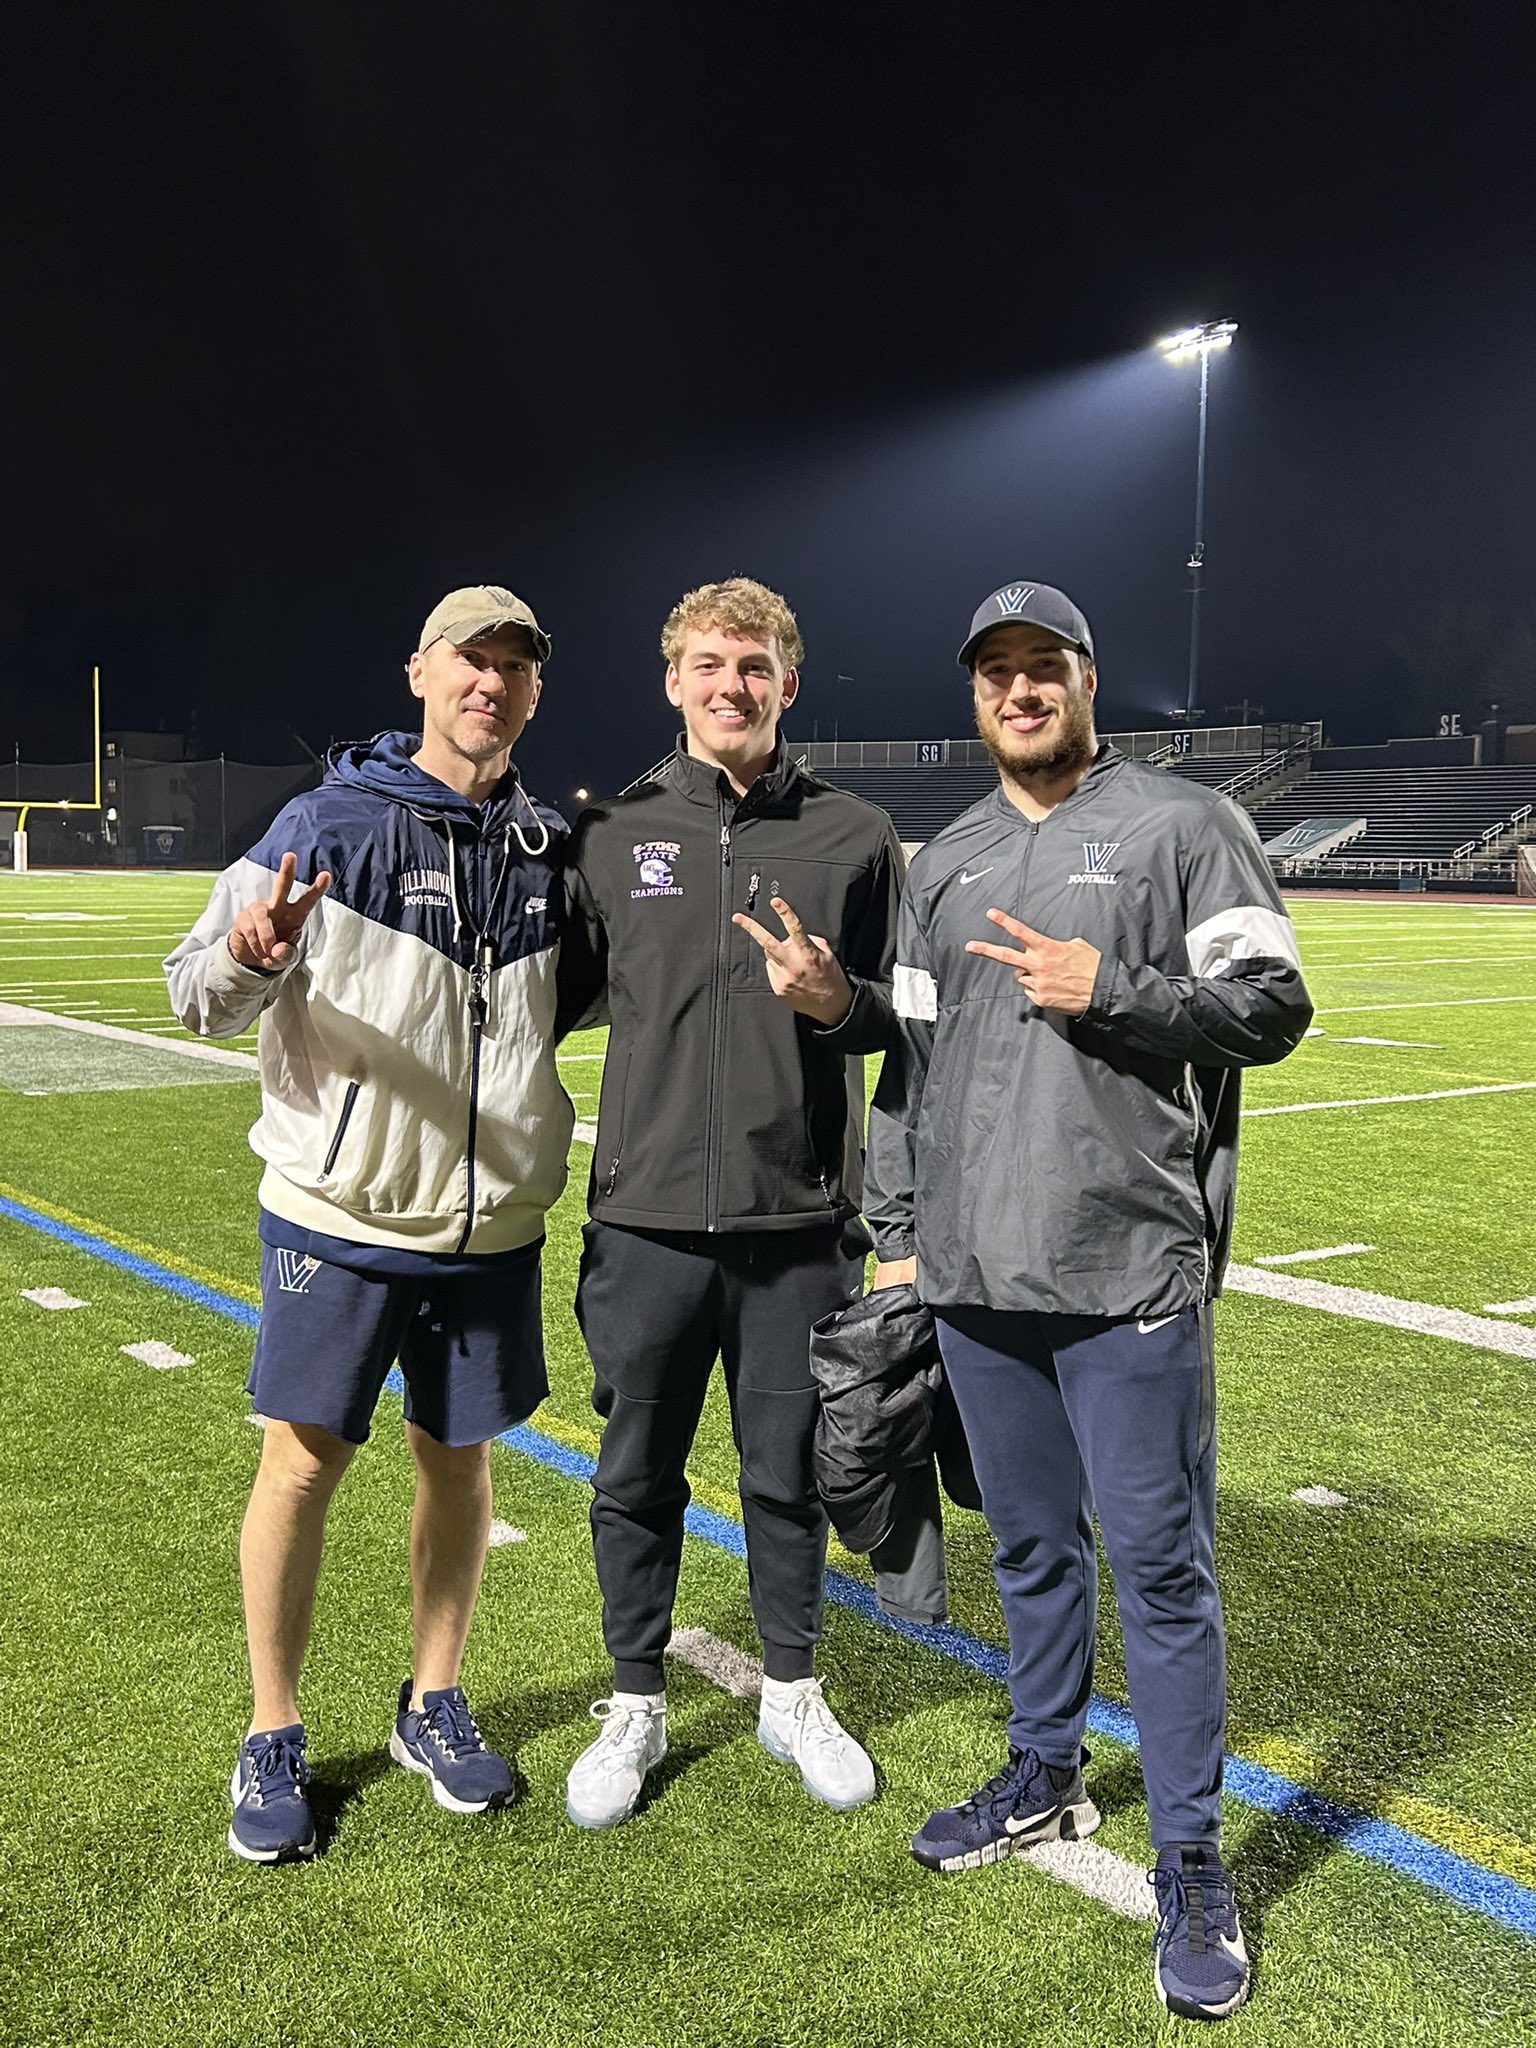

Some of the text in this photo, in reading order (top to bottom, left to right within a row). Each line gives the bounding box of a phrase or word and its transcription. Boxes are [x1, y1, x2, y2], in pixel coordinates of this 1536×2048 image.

[1440, 714, 1461, 736] SE
[1174, 734, 1191, 753] SF
[634, 852, 677, 863] STATE
[398, 869, 452, 897] VILLANOVA
[1067, 874, 1117, 884] FOOTBALL
[630, 887, 684, 899] CHAMPIONS
[404, 895, 448, 907] FOOTBALL
